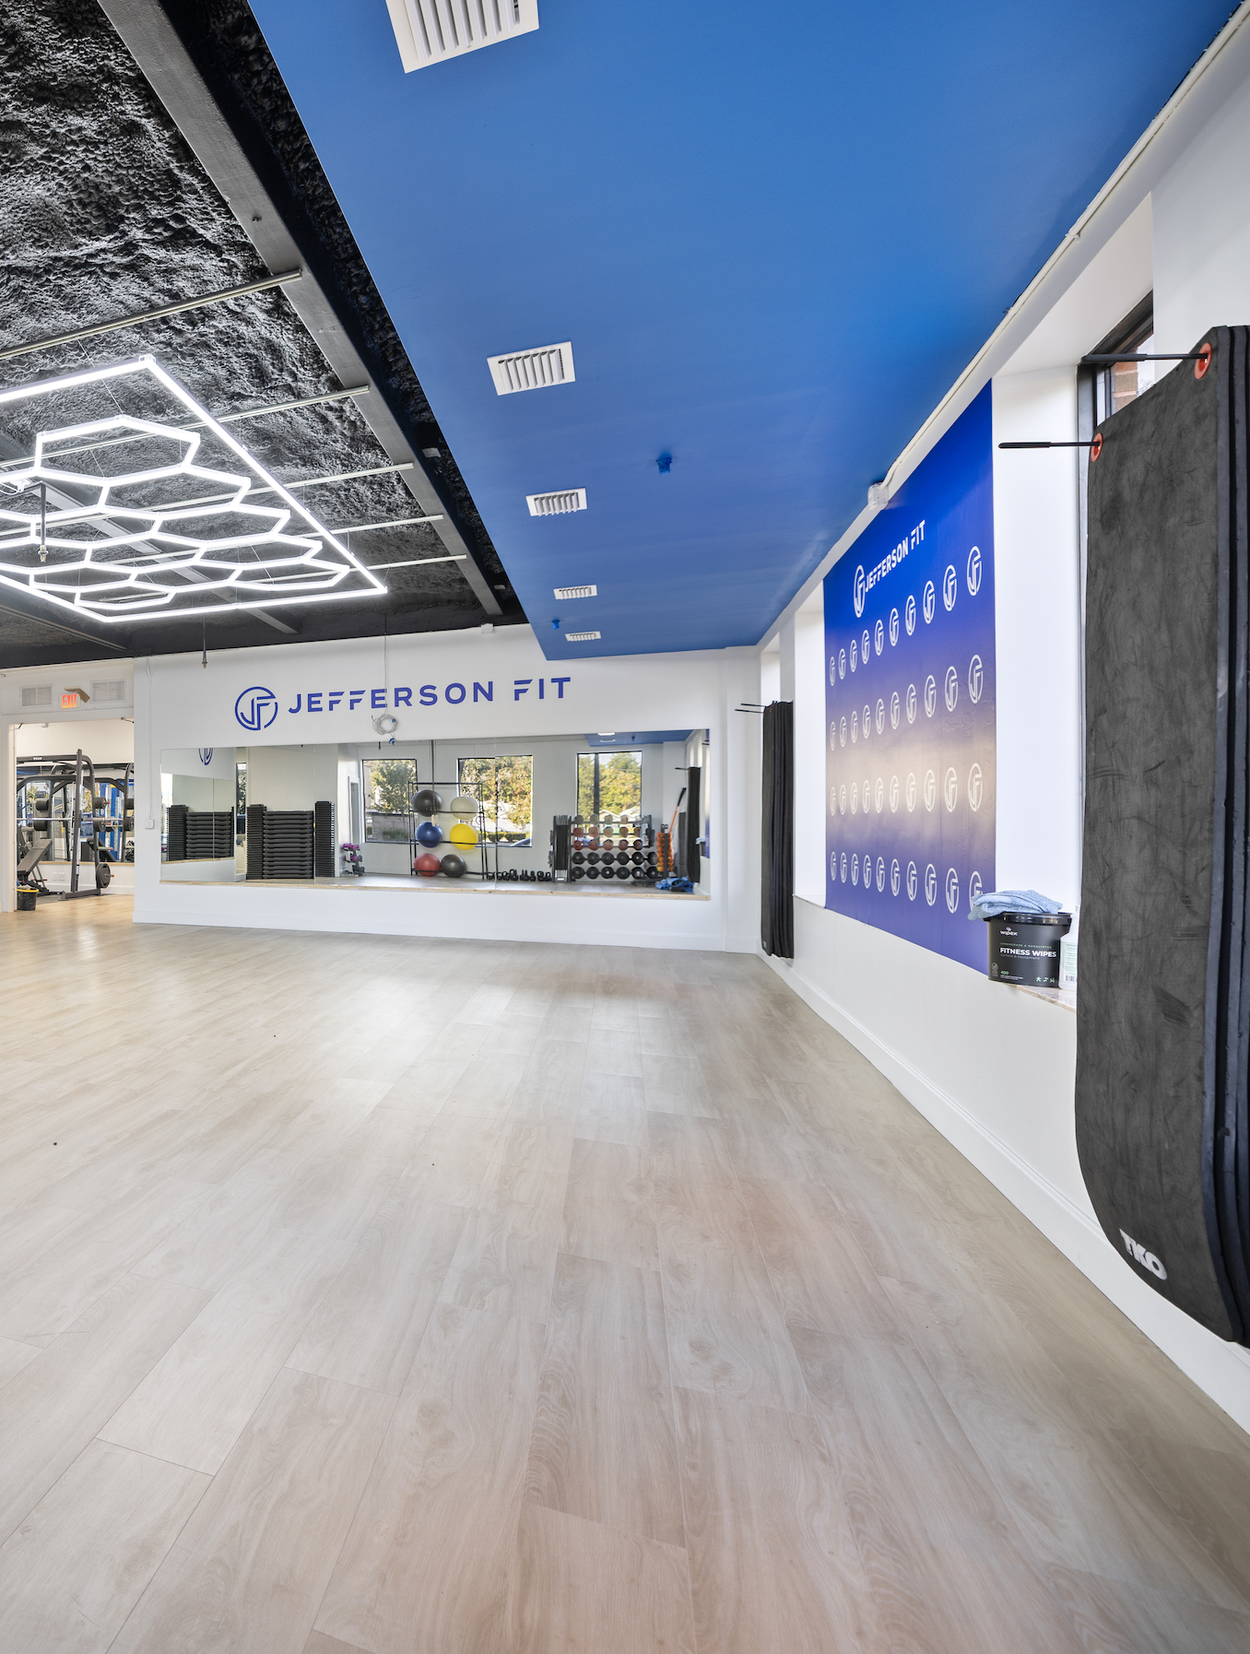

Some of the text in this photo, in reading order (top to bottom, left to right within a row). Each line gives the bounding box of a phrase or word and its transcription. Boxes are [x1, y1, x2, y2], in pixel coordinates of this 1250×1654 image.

[865, 537, 909, 592] JEFFERSON
[910, 519, 926, 550] FIT
[61, 693, 79, 709] EXIT
[288, 680, 494, 714] JEFFERSON
[513, 676, 571, 701] FIT
[1000, 947, 1030, 956] FITNESS
[1031, 950, 1057, 958] WIPES
